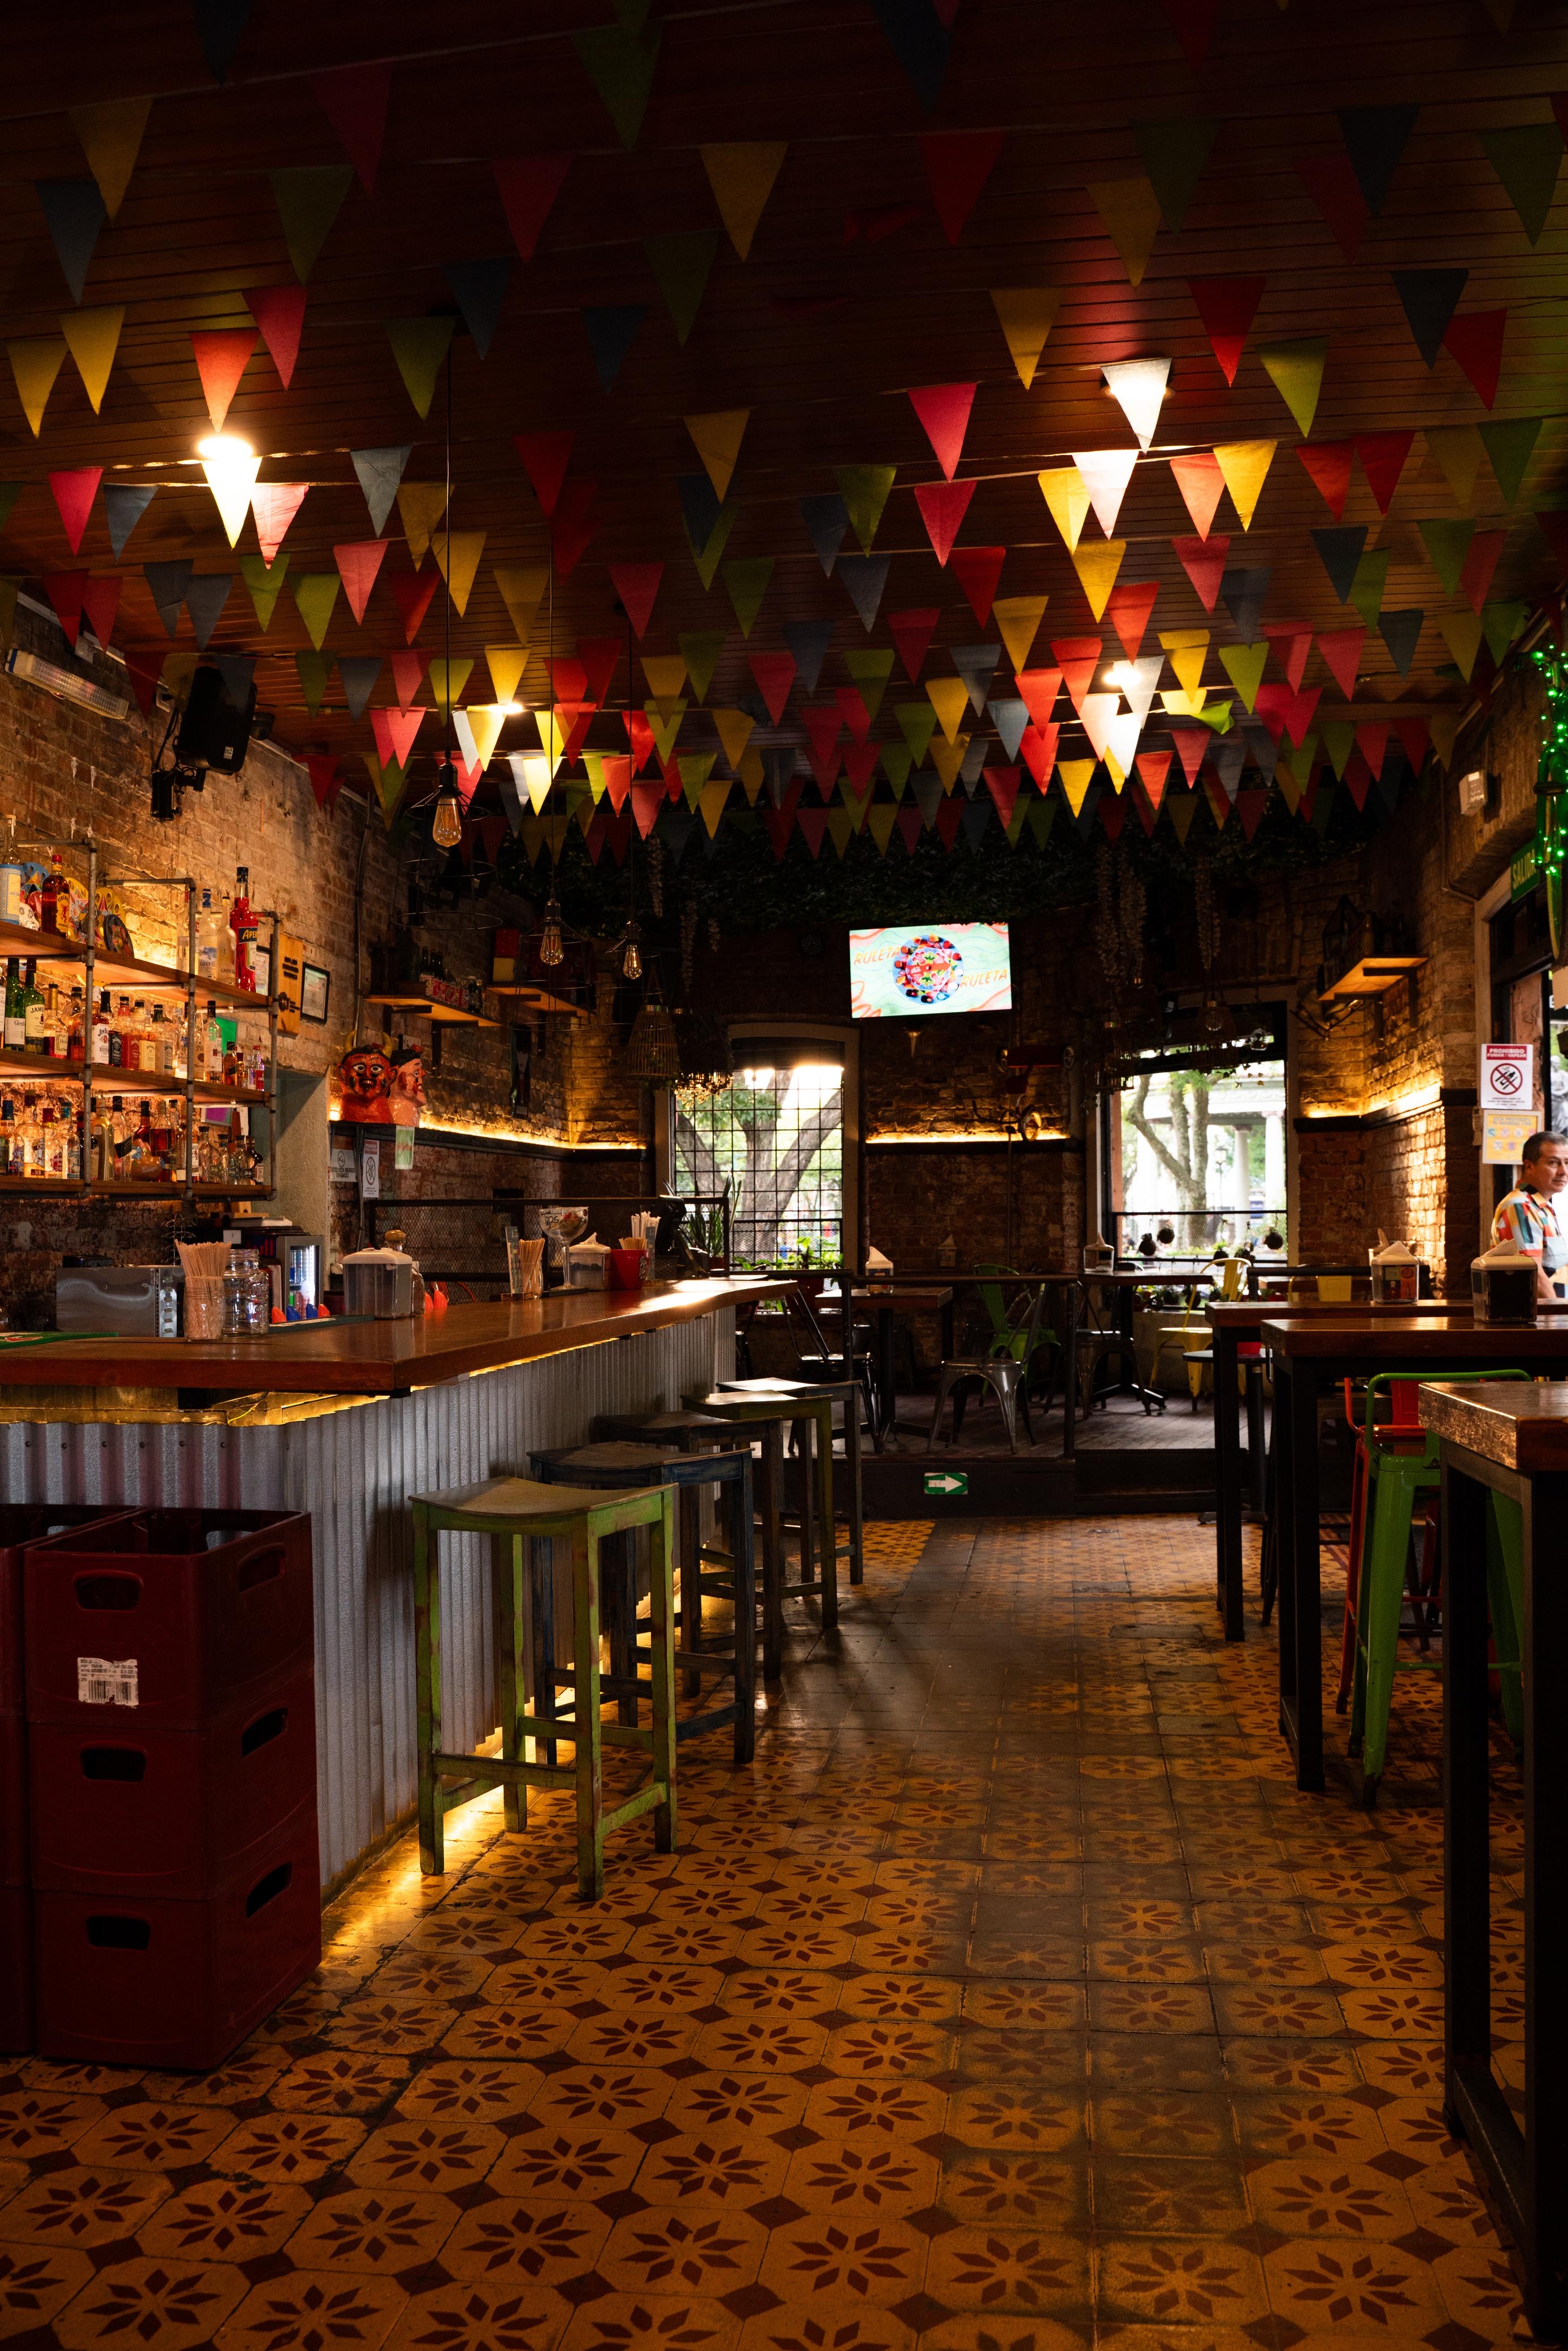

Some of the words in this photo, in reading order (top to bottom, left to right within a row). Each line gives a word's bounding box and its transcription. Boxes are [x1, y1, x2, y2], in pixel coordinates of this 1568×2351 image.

[853, 946, 900, 965] RULETA
[960, 969, 1007, 988] RULETA
[541, 1211, 559, 1229] Tips
